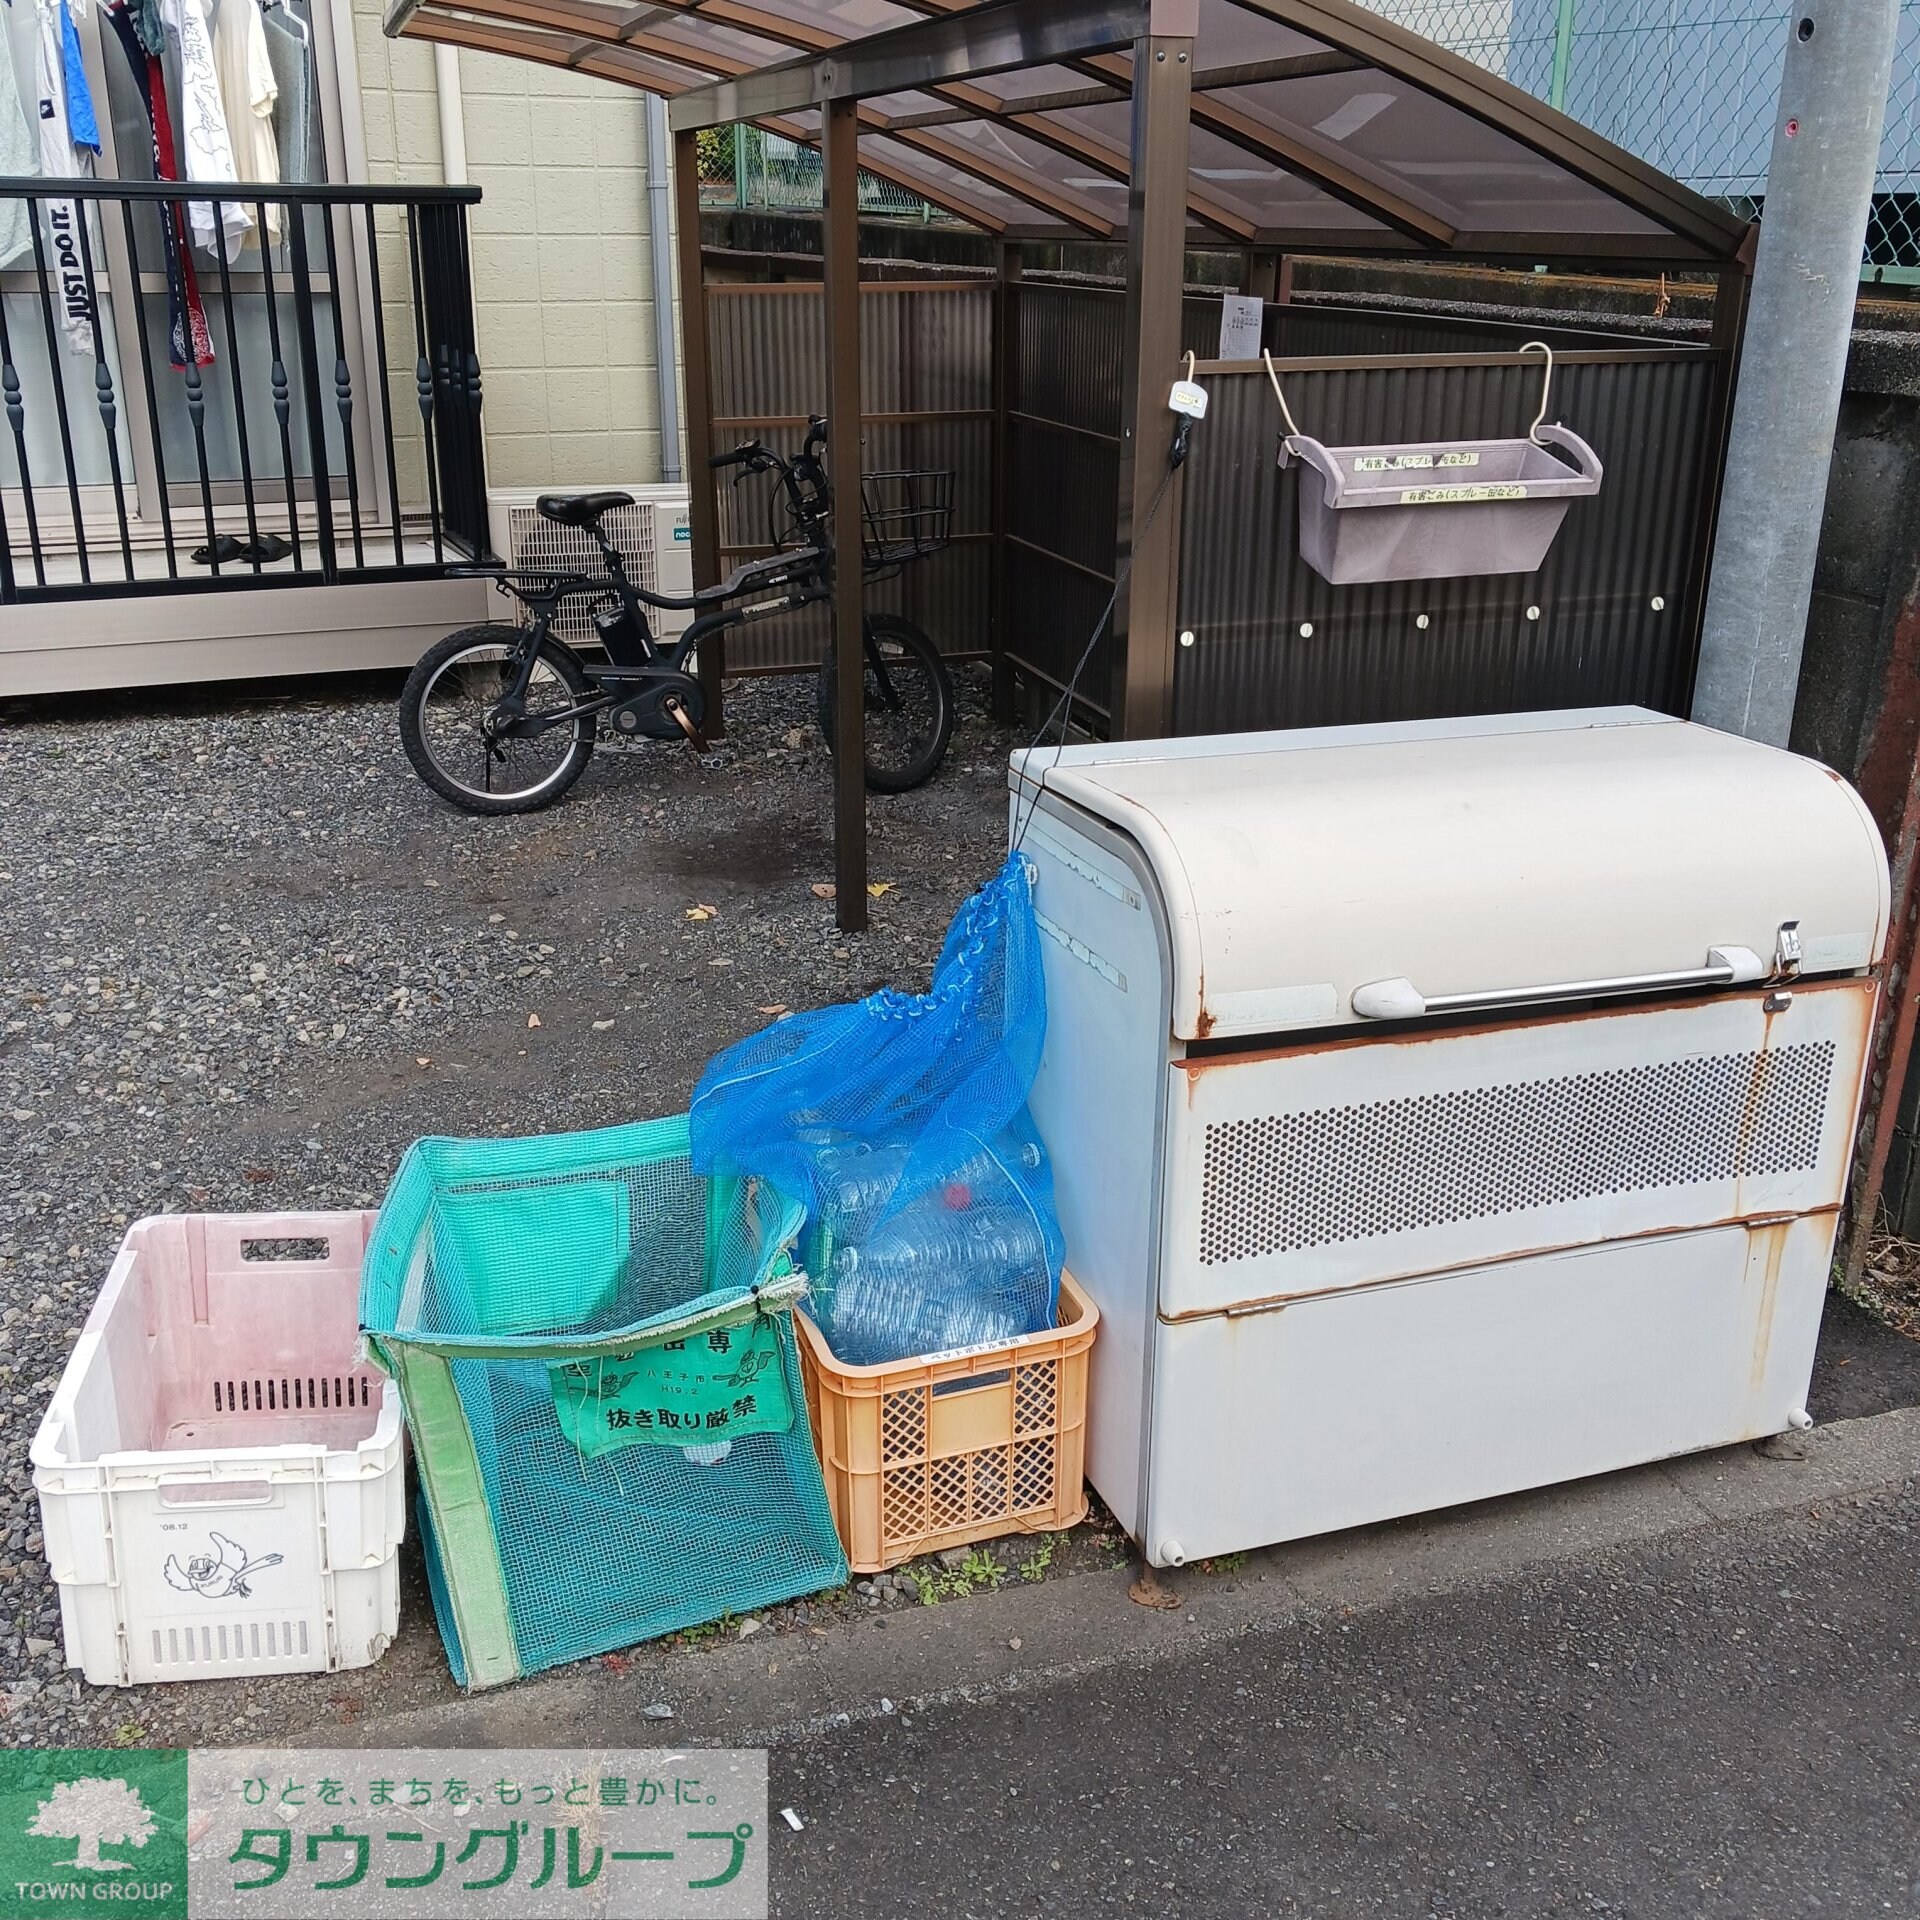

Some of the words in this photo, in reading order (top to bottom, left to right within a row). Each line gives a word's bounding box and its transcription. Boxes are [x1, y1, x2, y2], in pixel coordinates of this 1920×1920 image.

[51, 205, 70, 229] IT.
[55, 233, 79, 267] DO
[63, 271, 91, 321] JUST
[931, 1338, 1020, 1360] ペットボトル専用
[646, 1368, 706, 1383] 八王子市
[606, 1394, 757, 1431] 抜き取り厳禁
